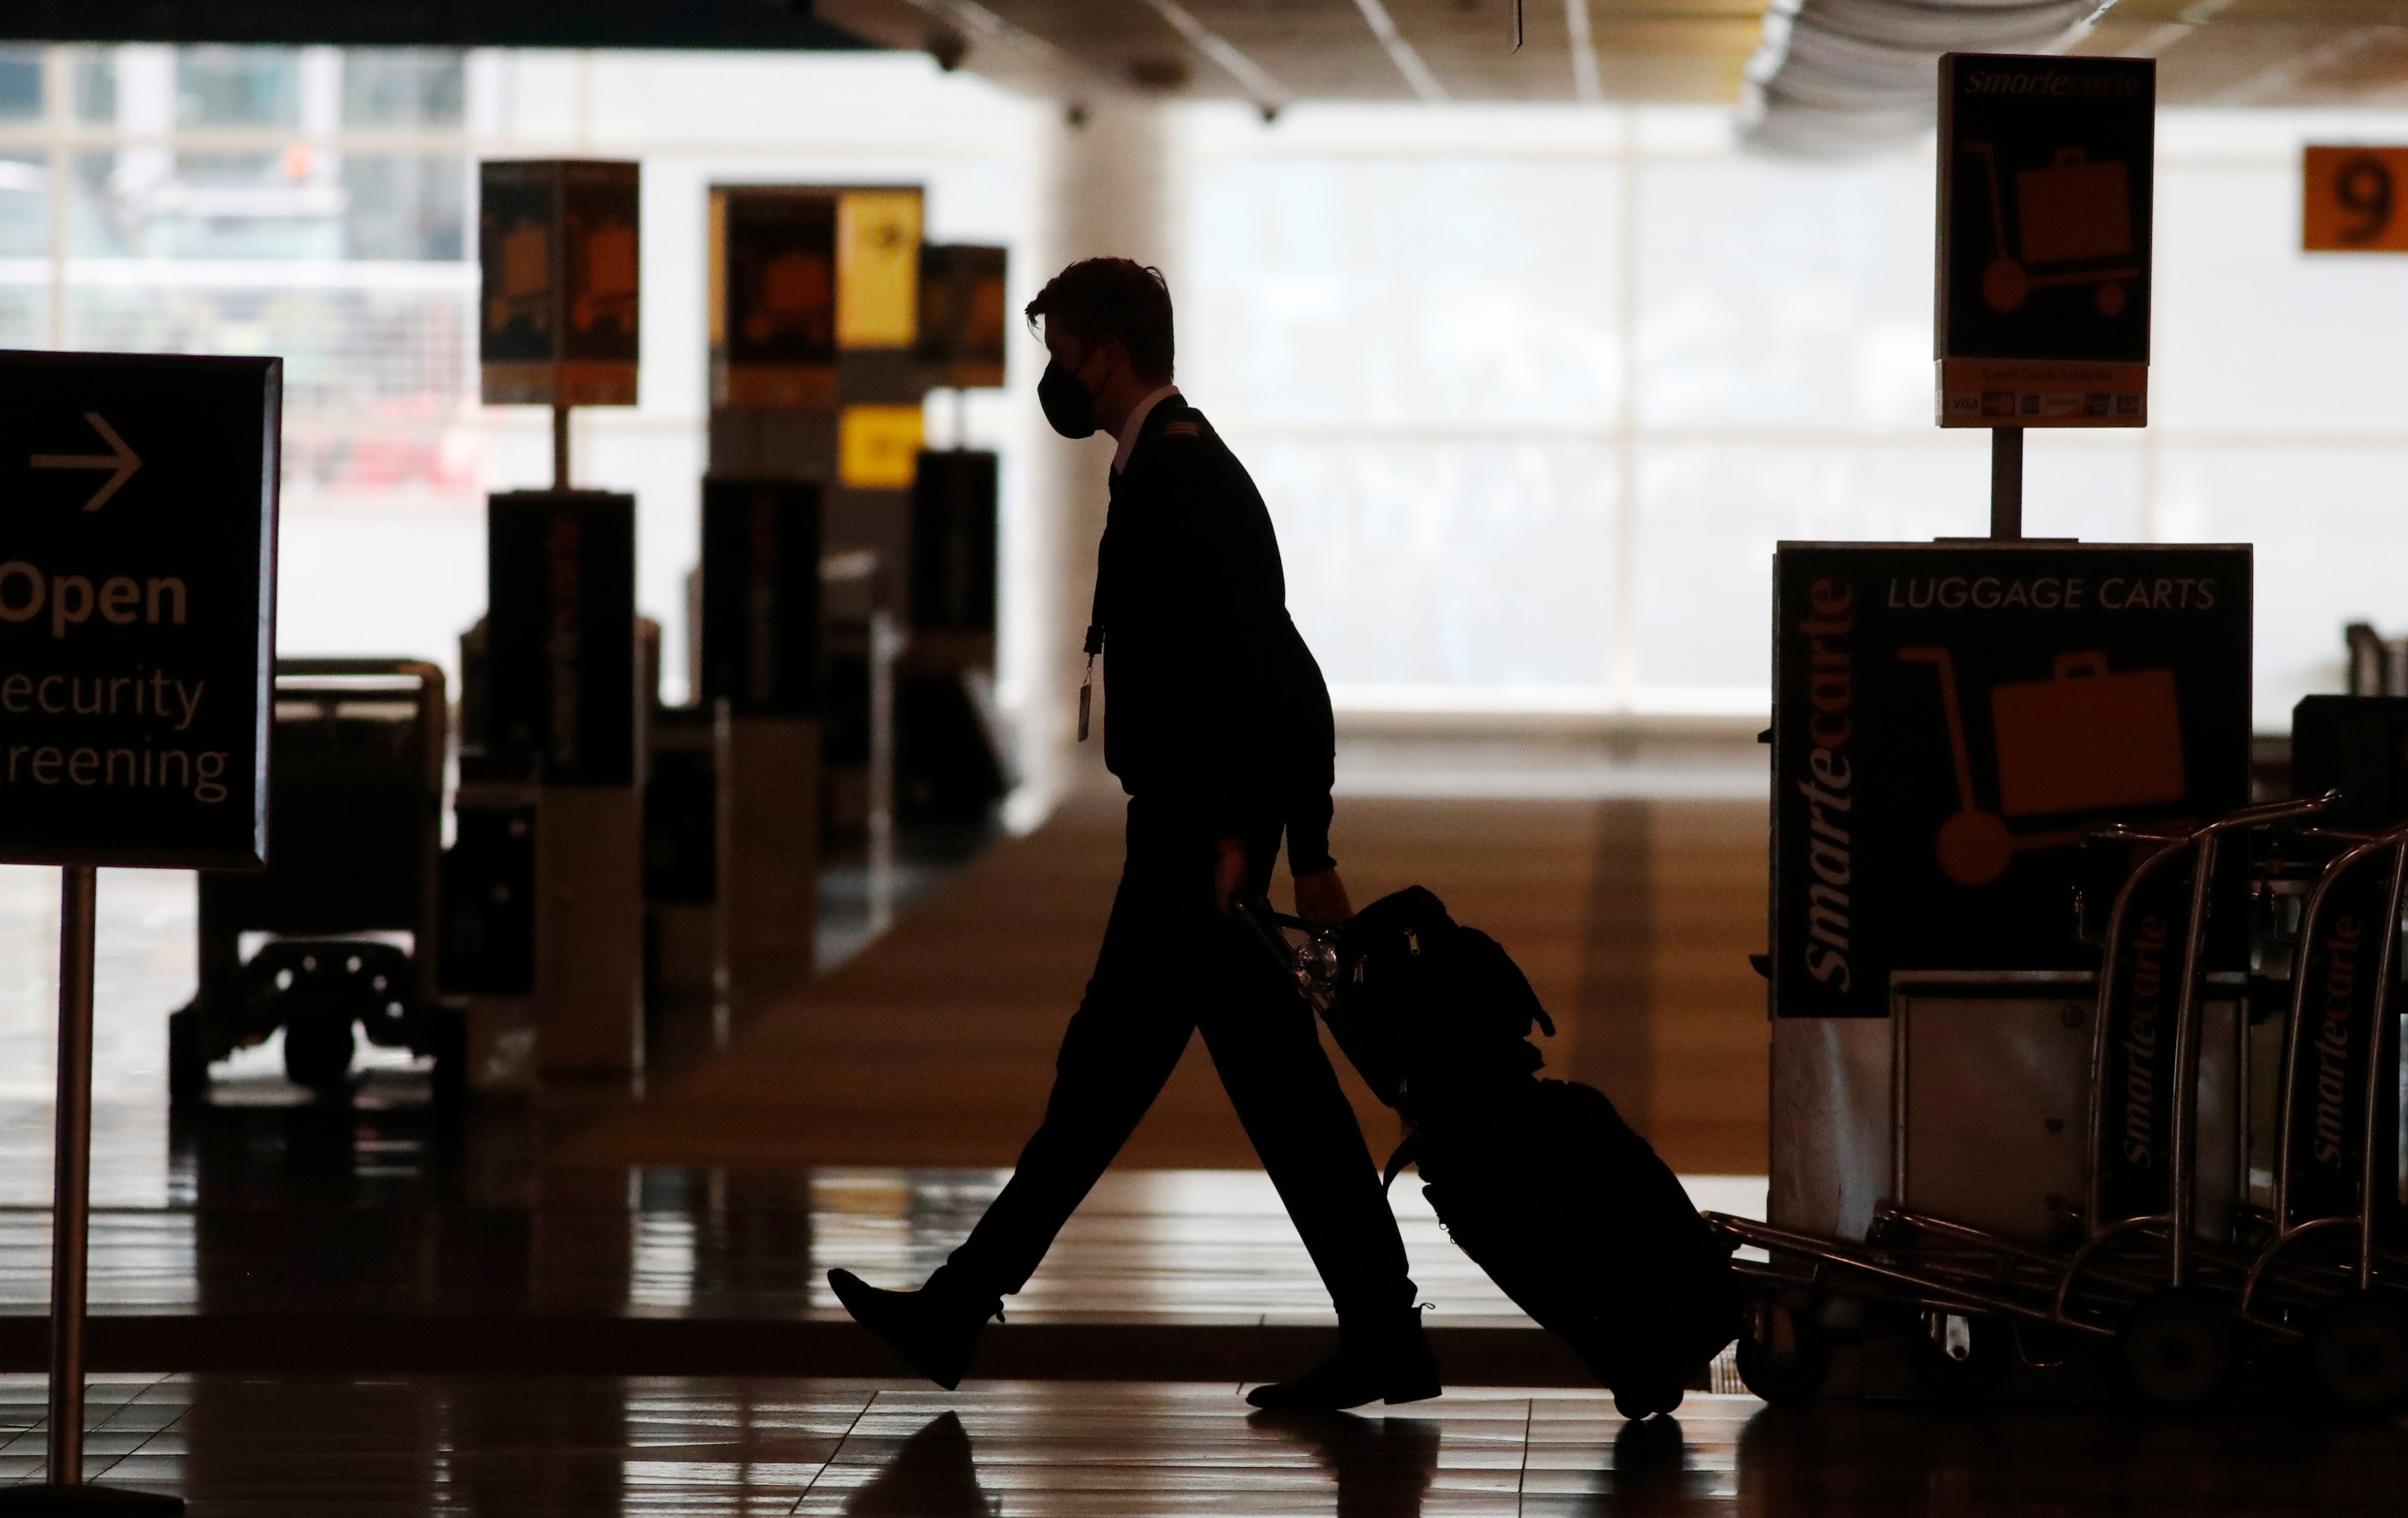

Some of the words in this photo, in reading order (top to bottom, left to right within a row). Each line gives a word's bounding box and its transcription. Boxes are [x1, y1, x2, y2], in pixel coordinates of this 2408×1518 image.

[2335, 156, 2393, 246] 9
[1952, 399, 1979, 409] VISA
[0, 560, 188, 640] Open
[1887, 576, 2084, 610] LUGGAGE
[2098, 577, 2217, 611] CARTS
[0, 734, 229, 803] reening
[1799, 575, 1855, 993] smartecarte
[2119, 913, 2168, 1170] smartecarte
[2314, 913, 2363, 1170] smartecarte
